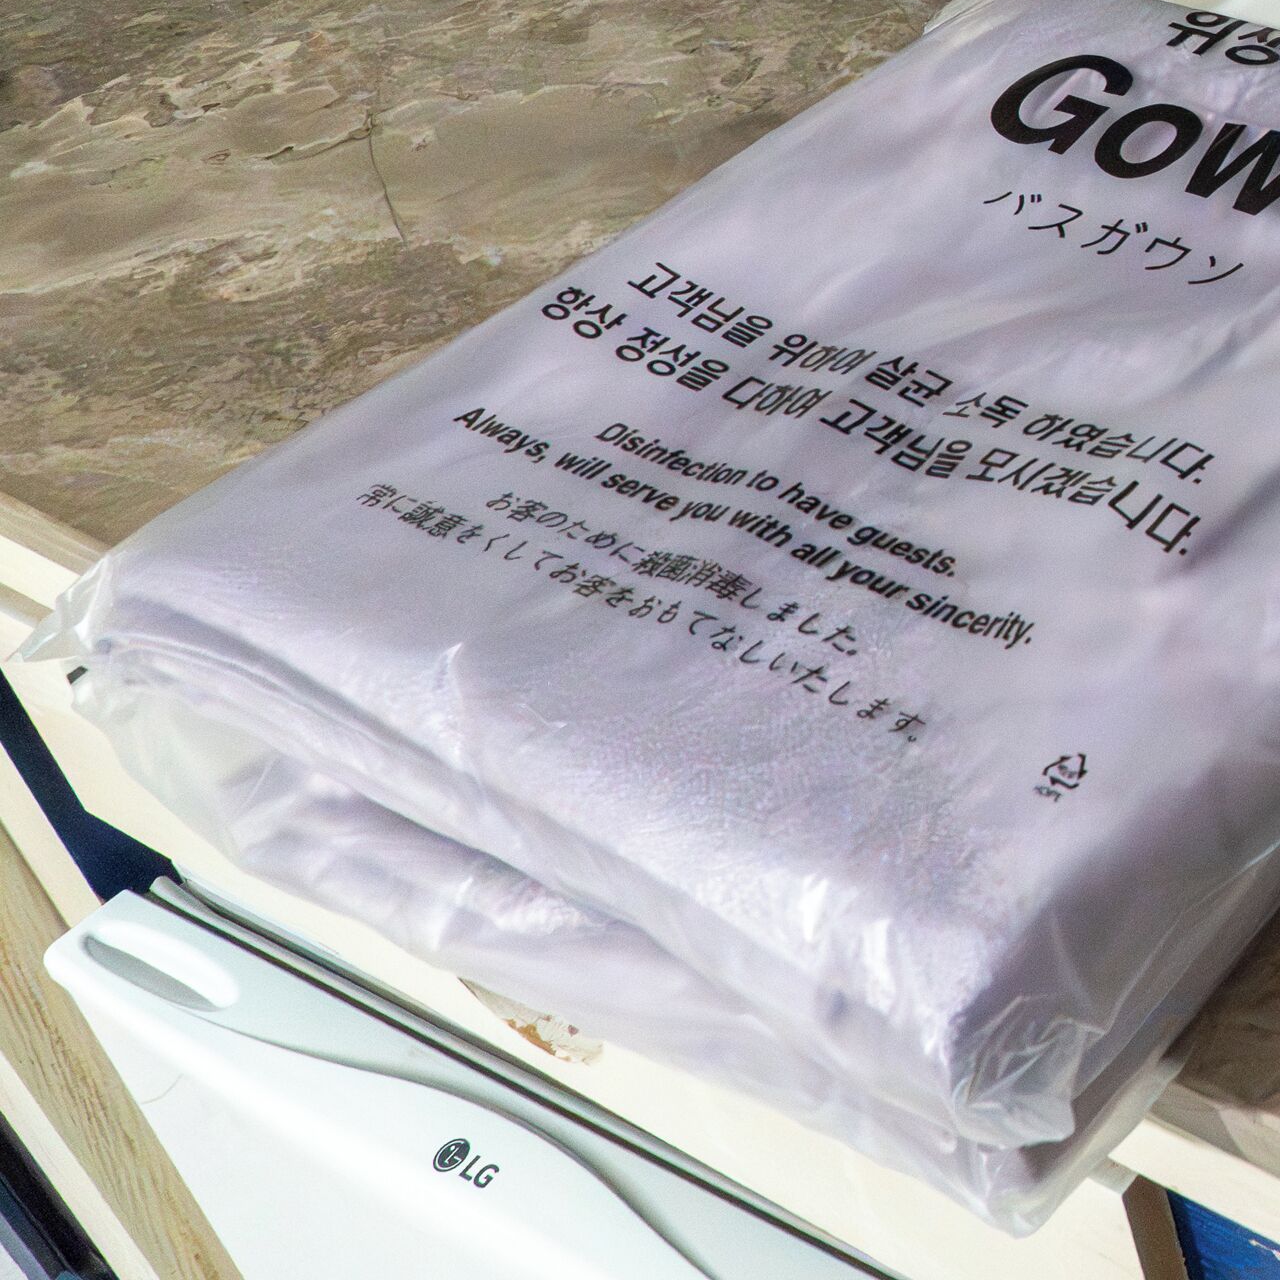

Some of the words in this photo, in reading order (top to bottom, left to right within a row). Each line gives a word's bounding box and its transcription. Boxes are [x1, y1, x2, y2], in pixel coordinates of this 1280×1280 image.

[983, 190, 1244, 285] バスガウン
[541, 286, 628, 340] 항상
[615, 326, 731, 392] 정성을
[722, 376, 833, 419] 다하여
[819, 398, 974, 480] 고객님을
[966, 447, 1202, 556] 모시겠습니다.
[627, 261, 774, 349] 고객님을
[768, 333, 877, 375] 위하여
[864, 355, 954, 408] 살균
[942, 391, 1030, 429] 소독
[1022, 412, 1215, 485] 하였습니다.
[452, 407, 551, 464] Always,
[554, 451, 613, 481] will
[600, 470, 682, 512] serve
[668, 499, 728, 522] you
[727, 507, 794, 549] with
[790, 541, 841, 570] all
[825, 561, 909, 601] your
[905, 591, 1034, 651] sincerity.
[594, 422, 749, 487] Disinfection
[745, 469, 780, 492] to
[778, 482, 854, 532] have
[846, 522, 957, 578] guests.
[459, 1154, 500, 1188] LG
